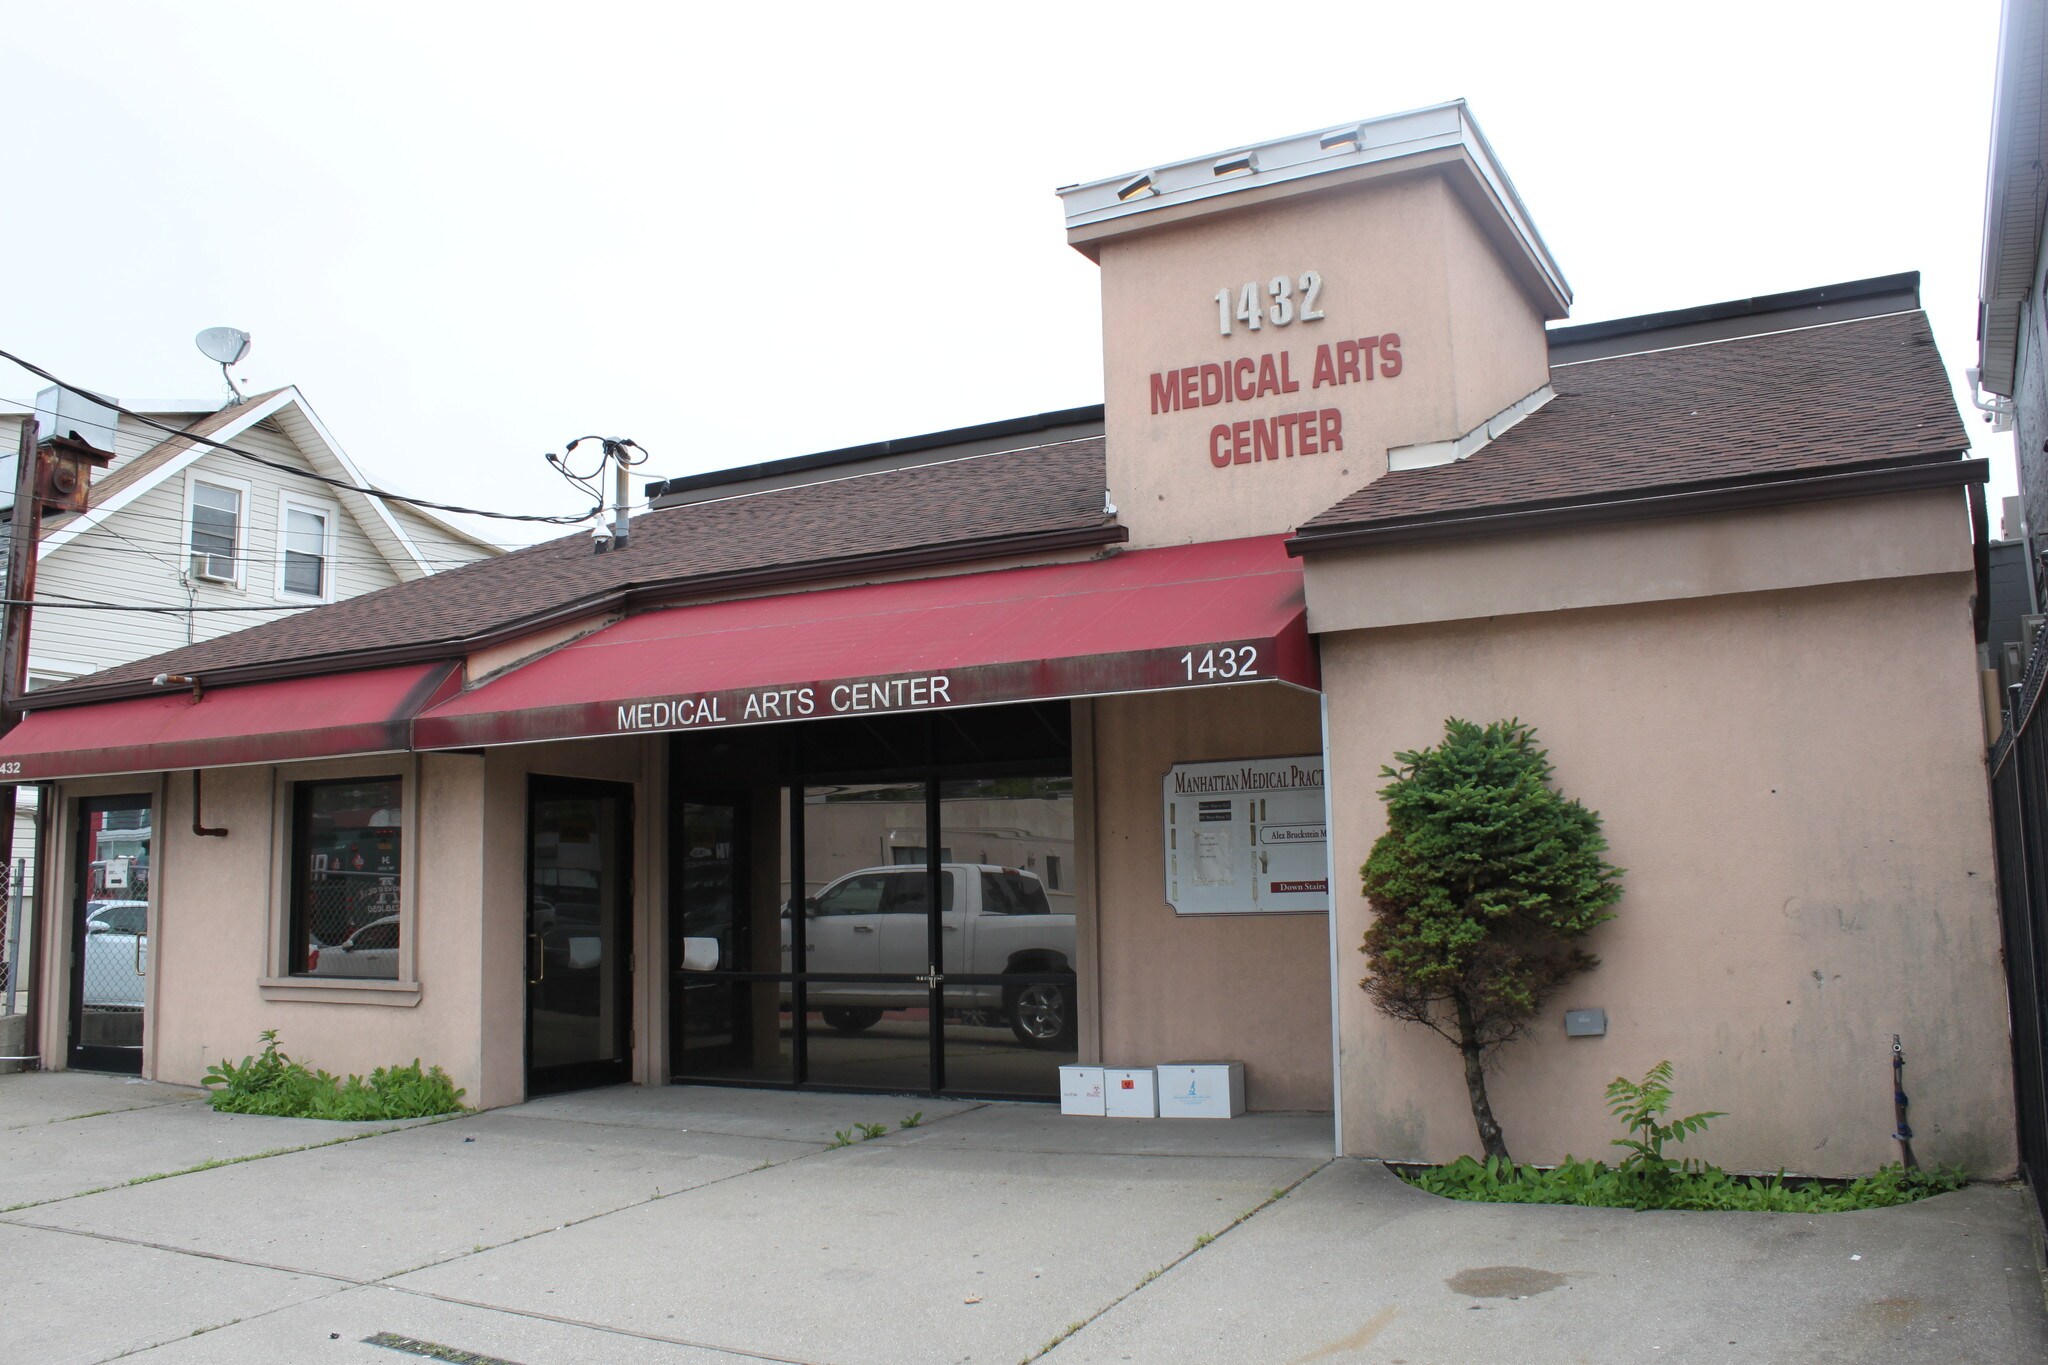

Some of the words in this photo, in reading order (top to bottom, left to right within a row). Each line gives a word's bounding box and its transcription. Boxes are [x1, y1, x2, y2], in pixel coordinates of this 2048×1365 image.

[1214, 270, 1326, 336] 1432
[1150, 351, 1300, 415] MEDICAL
[1312, 333, 1403, 389] ARTS
[1209, 408, 1343, 468] CENTER
[1180, 645, 1258, 681] 1432
[617, 697, 727, 730] MEDICAL
[743, 688, 815, 720] ARTS
[830, 675, 951, 712] CENTER
[1271, 830, 1286, 840] Alex
[1286, 829, 1320, 839] Bruckstein
[1280, 883, 1303, 891] Down
[1304, 882, 1326, 890] Stairs
